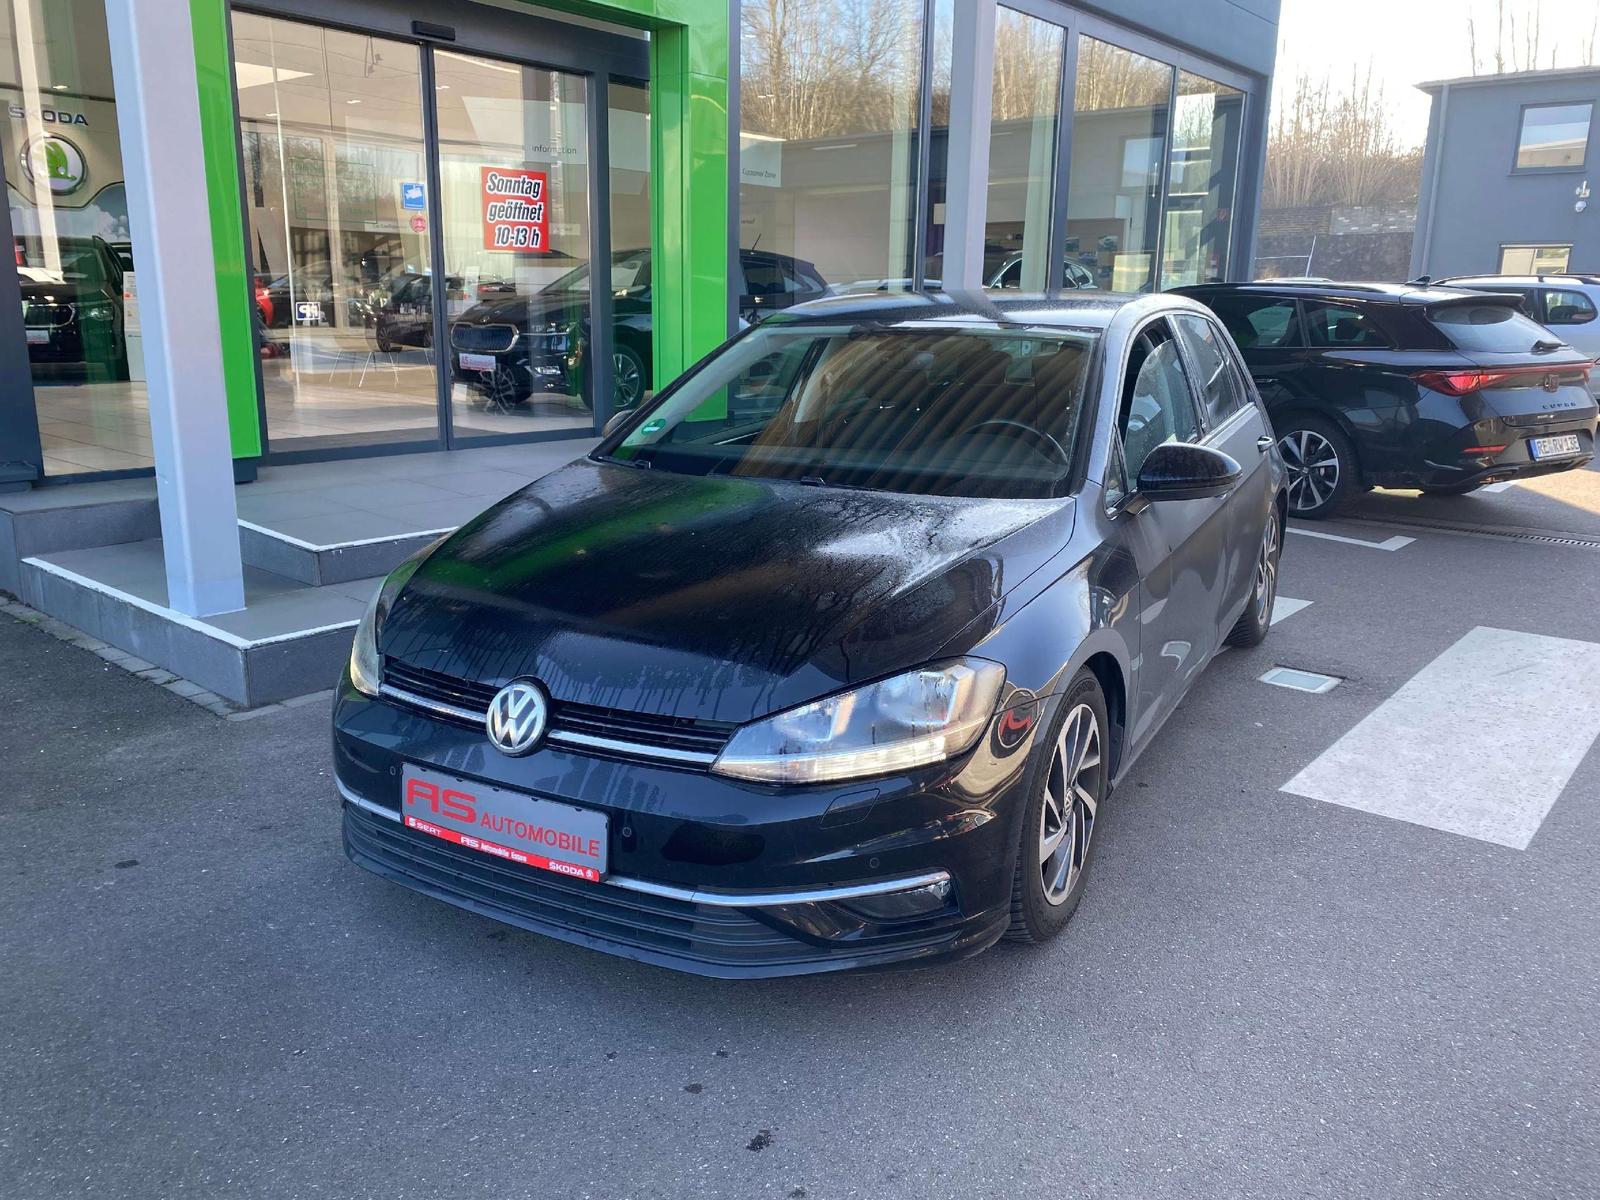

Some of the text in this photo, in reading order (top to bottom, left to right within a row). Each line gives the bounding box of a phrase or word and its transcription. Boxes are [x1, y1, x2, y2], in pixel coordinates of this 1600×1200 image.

[8, 105, 88, 126] SODA
[487, 172, 541, 199] Sonntag
[488, 201, 542, 221] geöffnet
[496, 225, 540, 247] 10-13 h
[487, 682, 546, 753] VW
[406, 778, 600, 858] AS AUTOMOBILE
[416, 822, 441, 836] SEAT
[460, 836, 480, 848] AS
